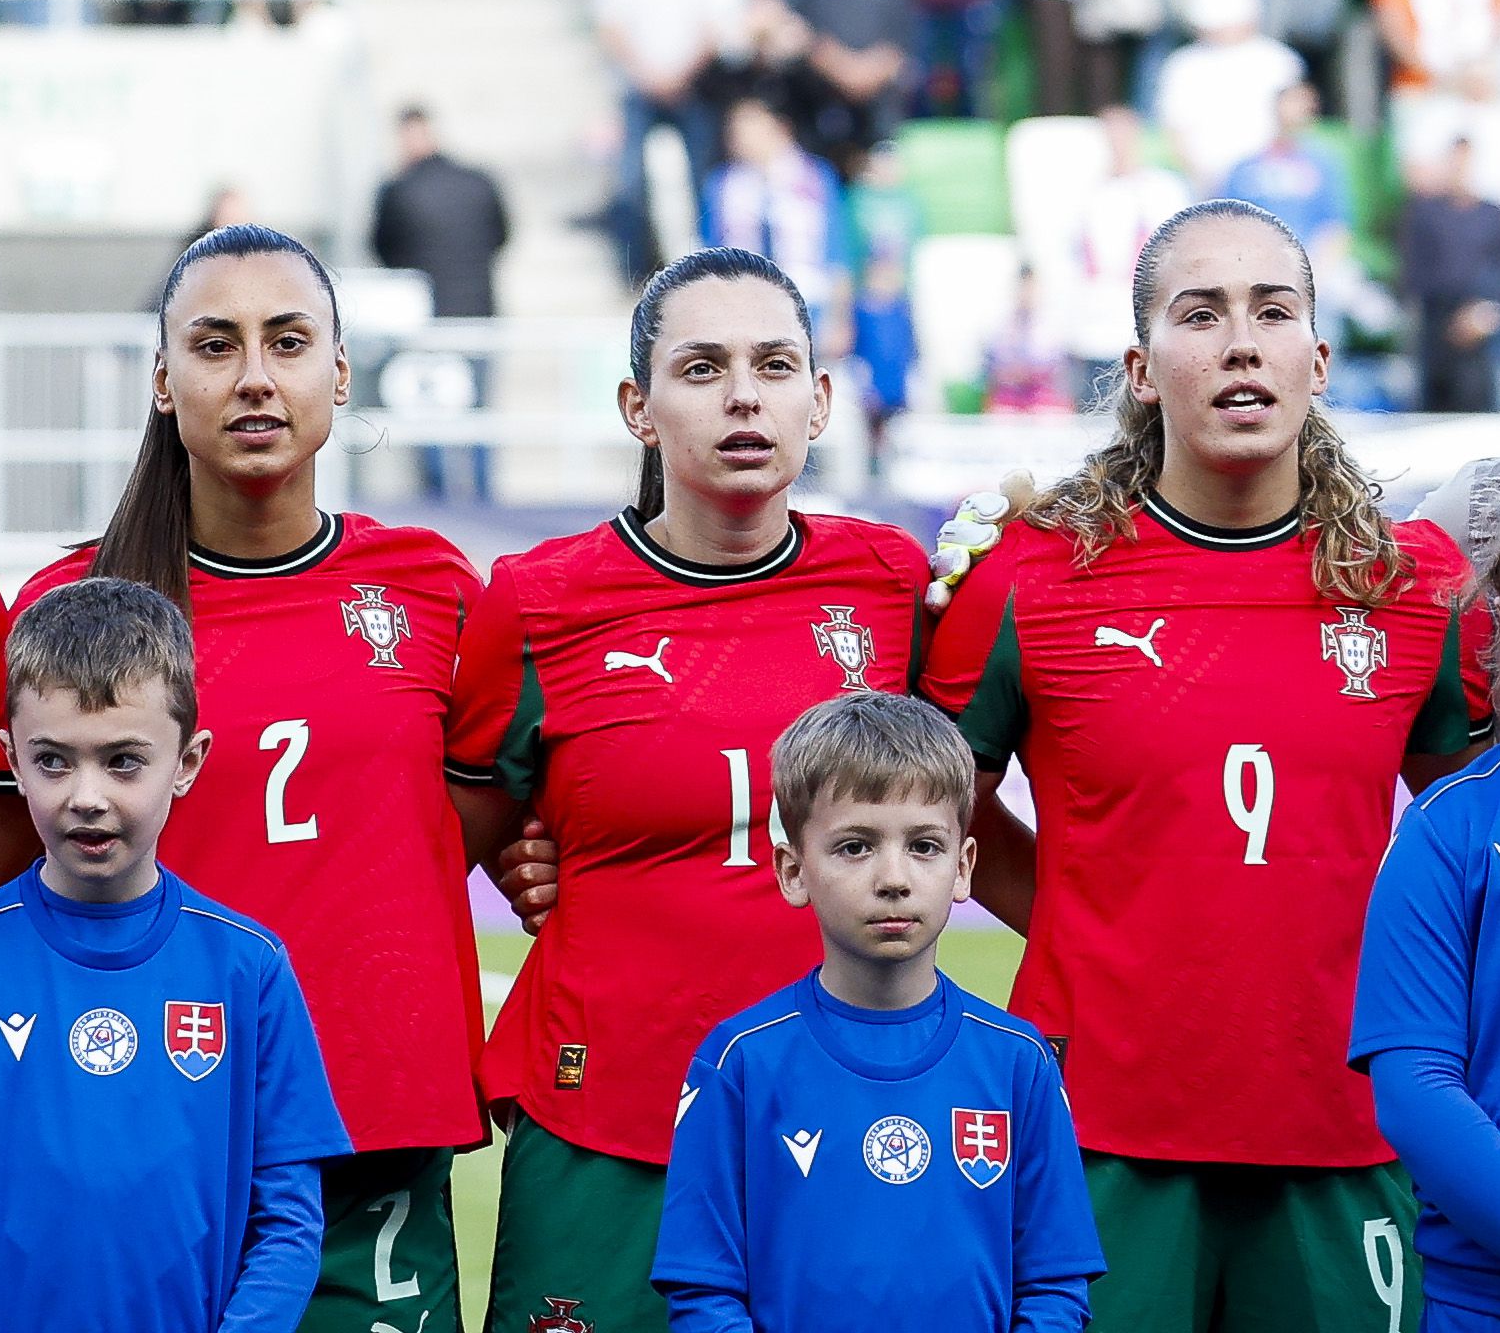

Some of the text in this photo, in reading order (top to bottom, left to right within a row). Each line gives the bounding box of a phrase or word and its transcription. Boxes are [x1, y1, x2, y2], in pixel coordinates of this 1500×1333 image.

[259, 718, 318, 844] 2
[1223, 744, 1274, 865] 9
[367, 1191, 421, 1302] 2
[1362, 1217, 1404, 1333] 9
